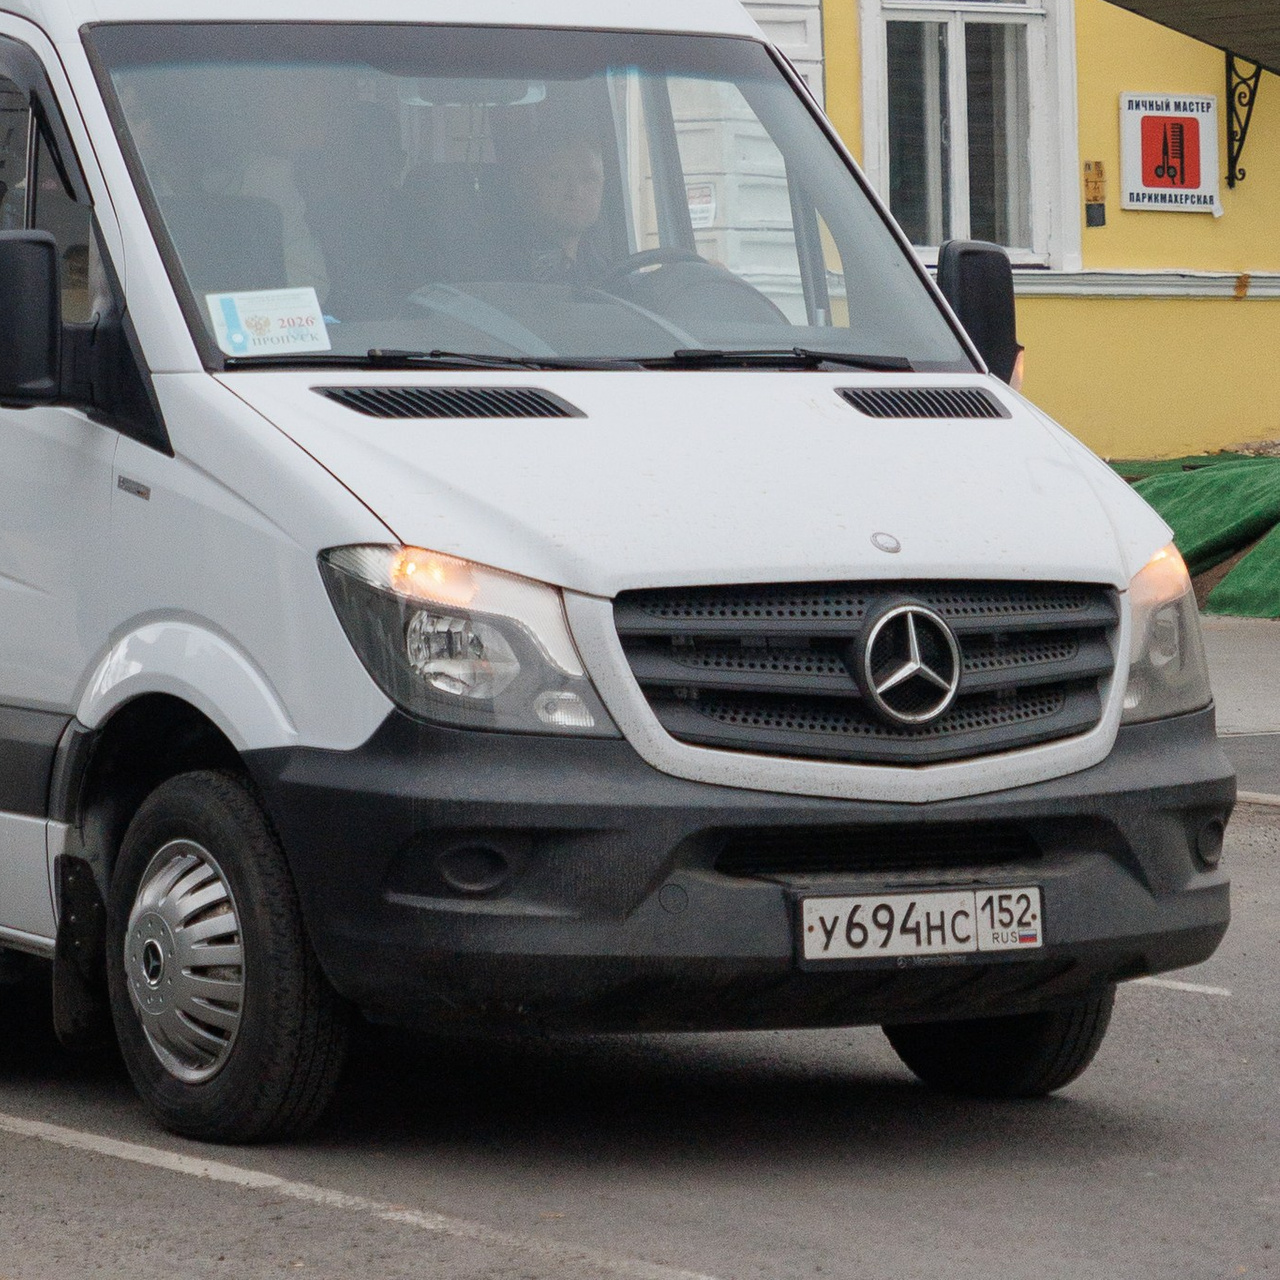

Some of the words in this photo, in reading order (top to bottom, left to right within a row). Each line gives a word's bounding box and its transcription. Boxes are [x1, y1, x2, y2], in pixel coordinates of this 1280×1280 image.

[1127, 98, 1170, 112] ЛИЧНЫЙ
[1174, 100, 1212, 113] МАСТЕР
[1129, 192, 1215, 205] ПАРИКМАХЕРСКАЯ
[278, 316, 316, 329] 2026
[252, 333, 320, 347] ПРОПУСК
[981, 893, 1032, 930] 152
[992, 931, 1019, 944] RUS
